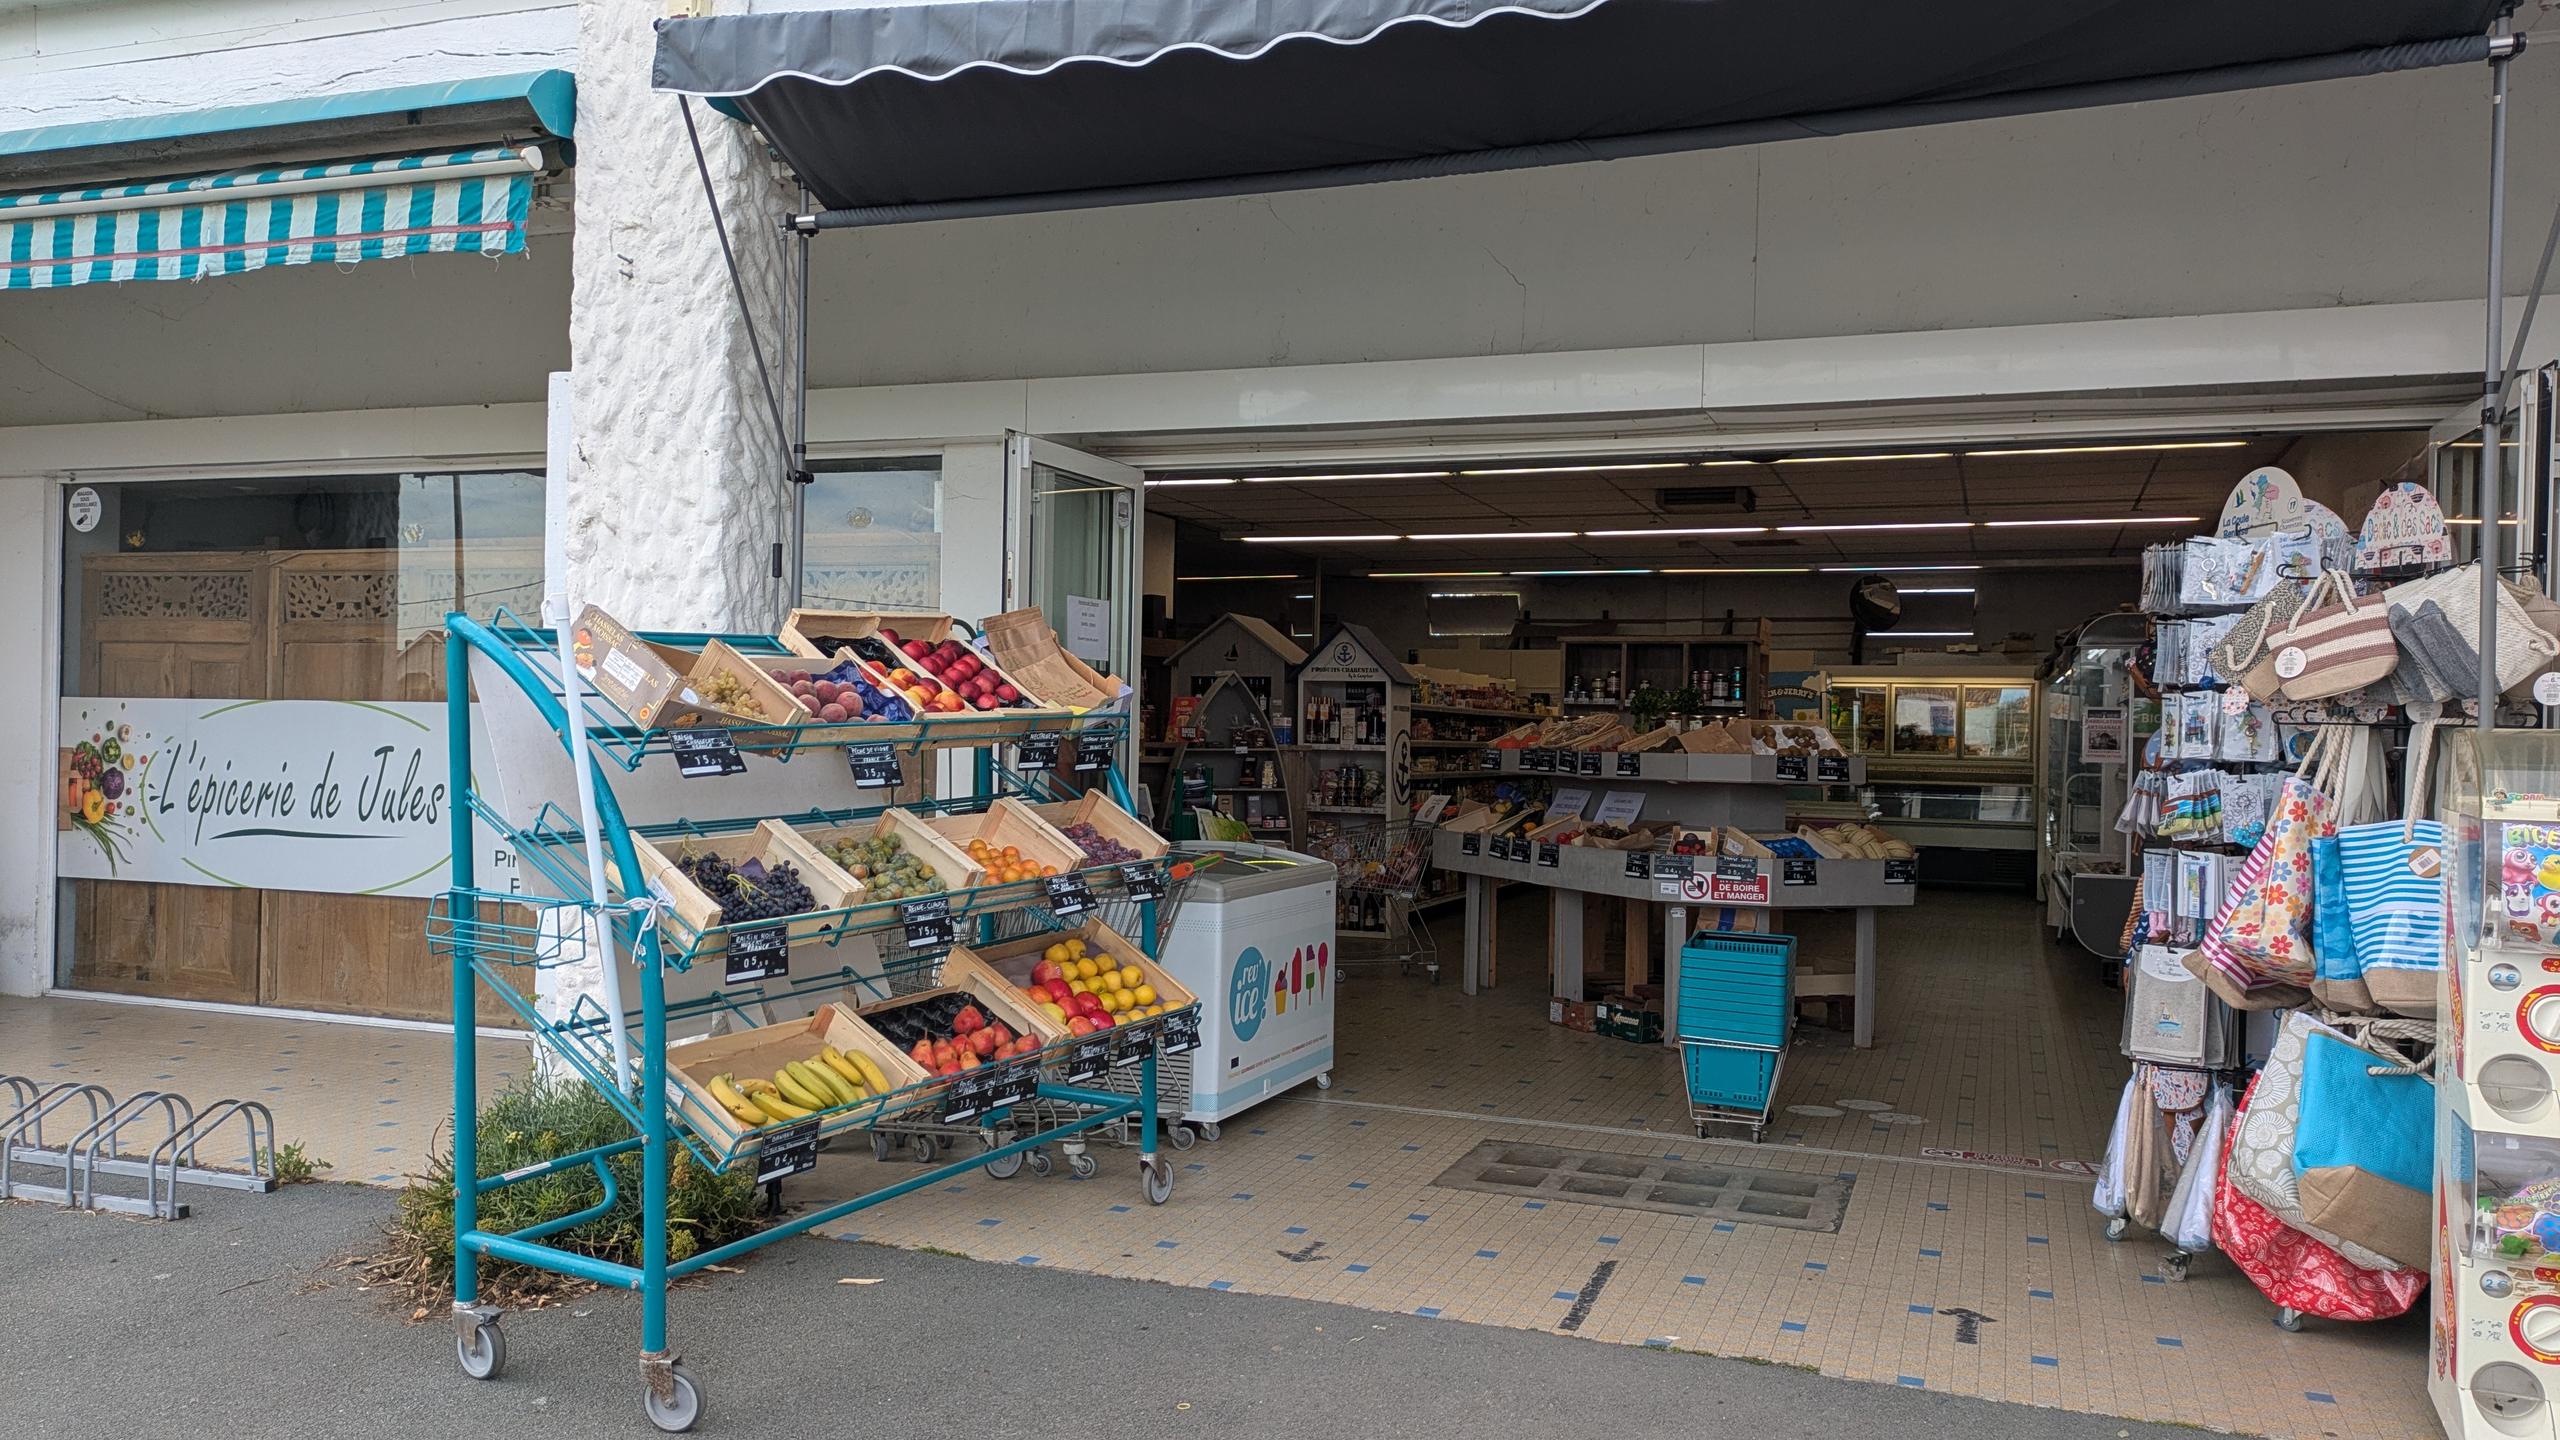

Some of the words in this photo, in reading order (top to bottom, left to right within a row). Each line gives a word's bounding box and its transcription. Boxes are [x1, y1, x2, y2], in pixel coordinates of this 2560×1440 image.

[2223, 518, 2231, 527] La
[2420, 510, 2442, 535] Sacs
[588, 610, 625, 642] CHASSELAS
[592, 624, 622, 649] MOISSAC
[159, 739, 296, 847] L'épicerie
[310, 751, 341, 821] de
[358, 745, 445, 825] Jules
[1733, 884, 1760, 892] BOIRE
[1726, 892, 1765, 901] MANGER
[736, 933, 759, 944] RAISIN
[2494, 972, 2502, 982] 2
[2505, 973, 2517, 983] €
[2485, 1278, 2494, 1288] 2
